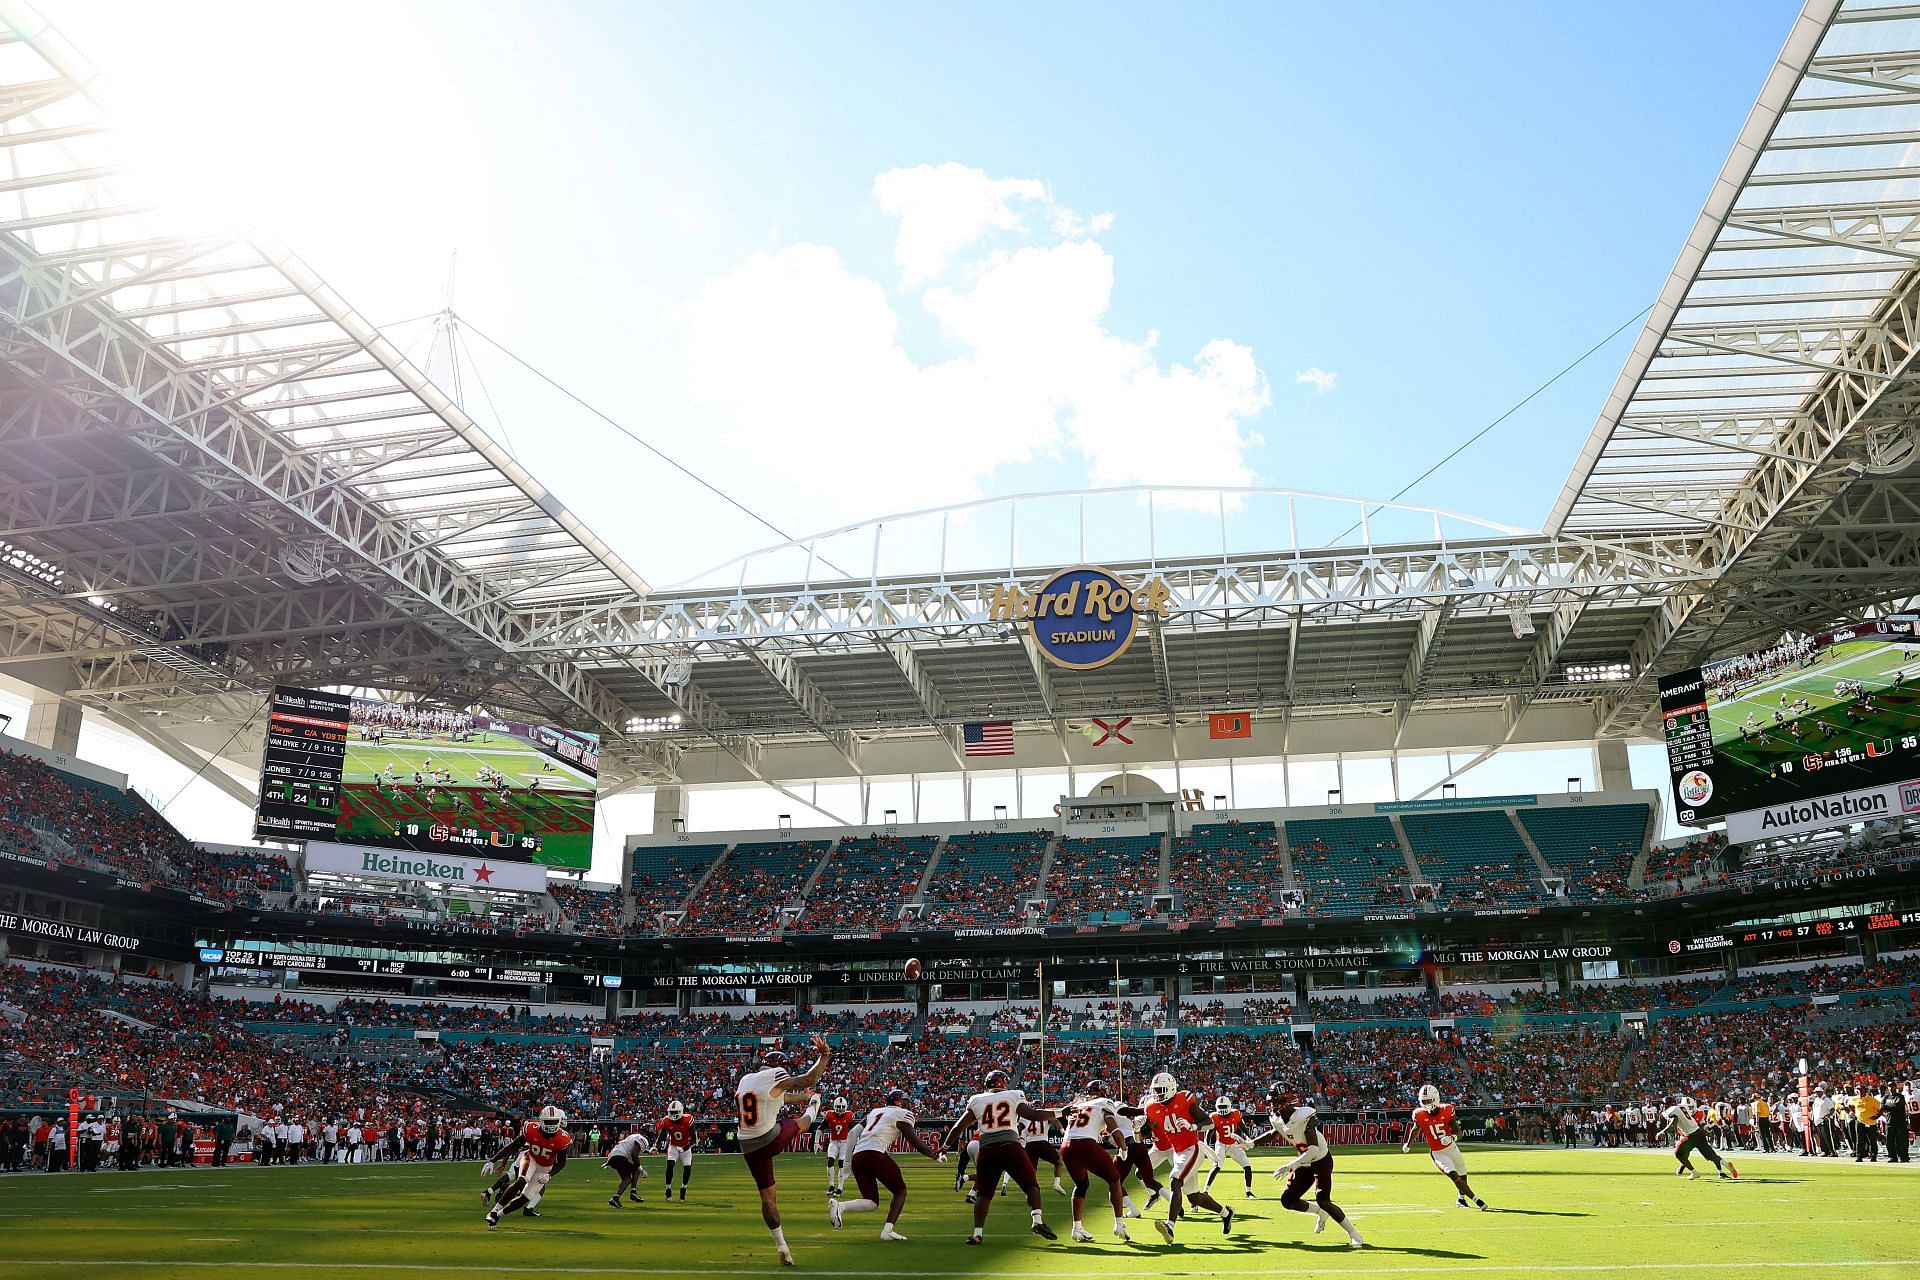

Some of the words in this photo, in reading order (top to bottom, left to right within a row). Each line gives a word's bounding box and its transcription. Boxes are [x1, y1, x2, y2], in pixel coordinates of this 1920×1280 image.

[989, 580, 1080, 620] Hard
[1084, 576, 1170, 622] Rock
[1051, 630, 1116, 644] STADIUM
[1660, 682, 1700, 698] AMERANT
[271, 724, 294, 734] Player
[1901, 736, 1918, 749] 35
[1835, 747, 1852, 758] 1:56
[55, 756, 66, 765] 351
[266, 765, 291, 774] JONES
[1780, 762, 1793, 773] 10
[267, 792, 284, 800] 4TH
[294, 794, 307, 803] 24
[321, 797, 329, 806] 11
[1682, 811, 1693, 820] CC
[1762, 793, 1888, 829] AutoNation
[406, 824, 418, 836] 10
[461, 828, 478, 837] 1:56
[522, 837, 534, 848] 35
[18, 856, 47, 867] KENNEDY
[362, 852, 464, 880] Heineken
[1774, 877, 1809, 890] RING
[1823, 868, 1876, 882] HONOR
[1870, 914, 1893, 923] TEAM
[407, 922, 440, 931] RING
[453, 926, 498, 936] HONOR
[1838, 921, 1854, 931] 3.4
[1868, 919, 1900, 930] LEADER
[21, 918, 74, 939] MORGAN
[77, 929, 102, 944] LAW
[104, 934, 139, 950] GROUP
[955, 928, 994, 937] NATIONAL
[995, 927, 1045, 936] CHAMPIONS
[1761, 931, 1773, 940] 17
[1777, 929, 1793, 937] YDS
[1797, 927, 1809, 935] 57
[1693, 935, 1724, 944] WILDCATS
[1744, 933, 1758, 941] ATT
[1705, 940, 1733, 949] RUSHING
[1434, 953, 1455, 963] MLG
[1460, 952, 1483, 962] THE
[1488, 949, 1539, 961] MORGAN
[1544, 948, 1569, 959] LAW
[1572, 947, 1612, 957] GROUP
[1200, 962, 1227, 972] FIRE.
[1231, 960, 1272, 971] WATER.
[1275, 958, 1314, 969] STORM
[1318, 956, 1372, 968] DAMAGE.
[654, 977, 674, 986] MLG
[678, 977, 698, 985] THE
[702, 975, 747, 985] MORGAN
[752, 975, 774, 984] LAW
[777, 974, 812, 984] GROUP
[921, 970, 936, 981] OR
[939, 970, 978, 980] DENIED
[981, 969, 1021, 979] CLAIM?
[1277, 1085, 1286, 1094] 16
[1908, 1101, 1919, 1112] 19
[981, 1102, 1011, 1129] 42
[867, 1112, 883, 1131] 1
[1027, 1118, 1045, 1135] 41
[835, 1124, 843, 1134] 9
[1429, 1123, 1446, 1140] 15
[674, 1132, 682, 1140] 0
